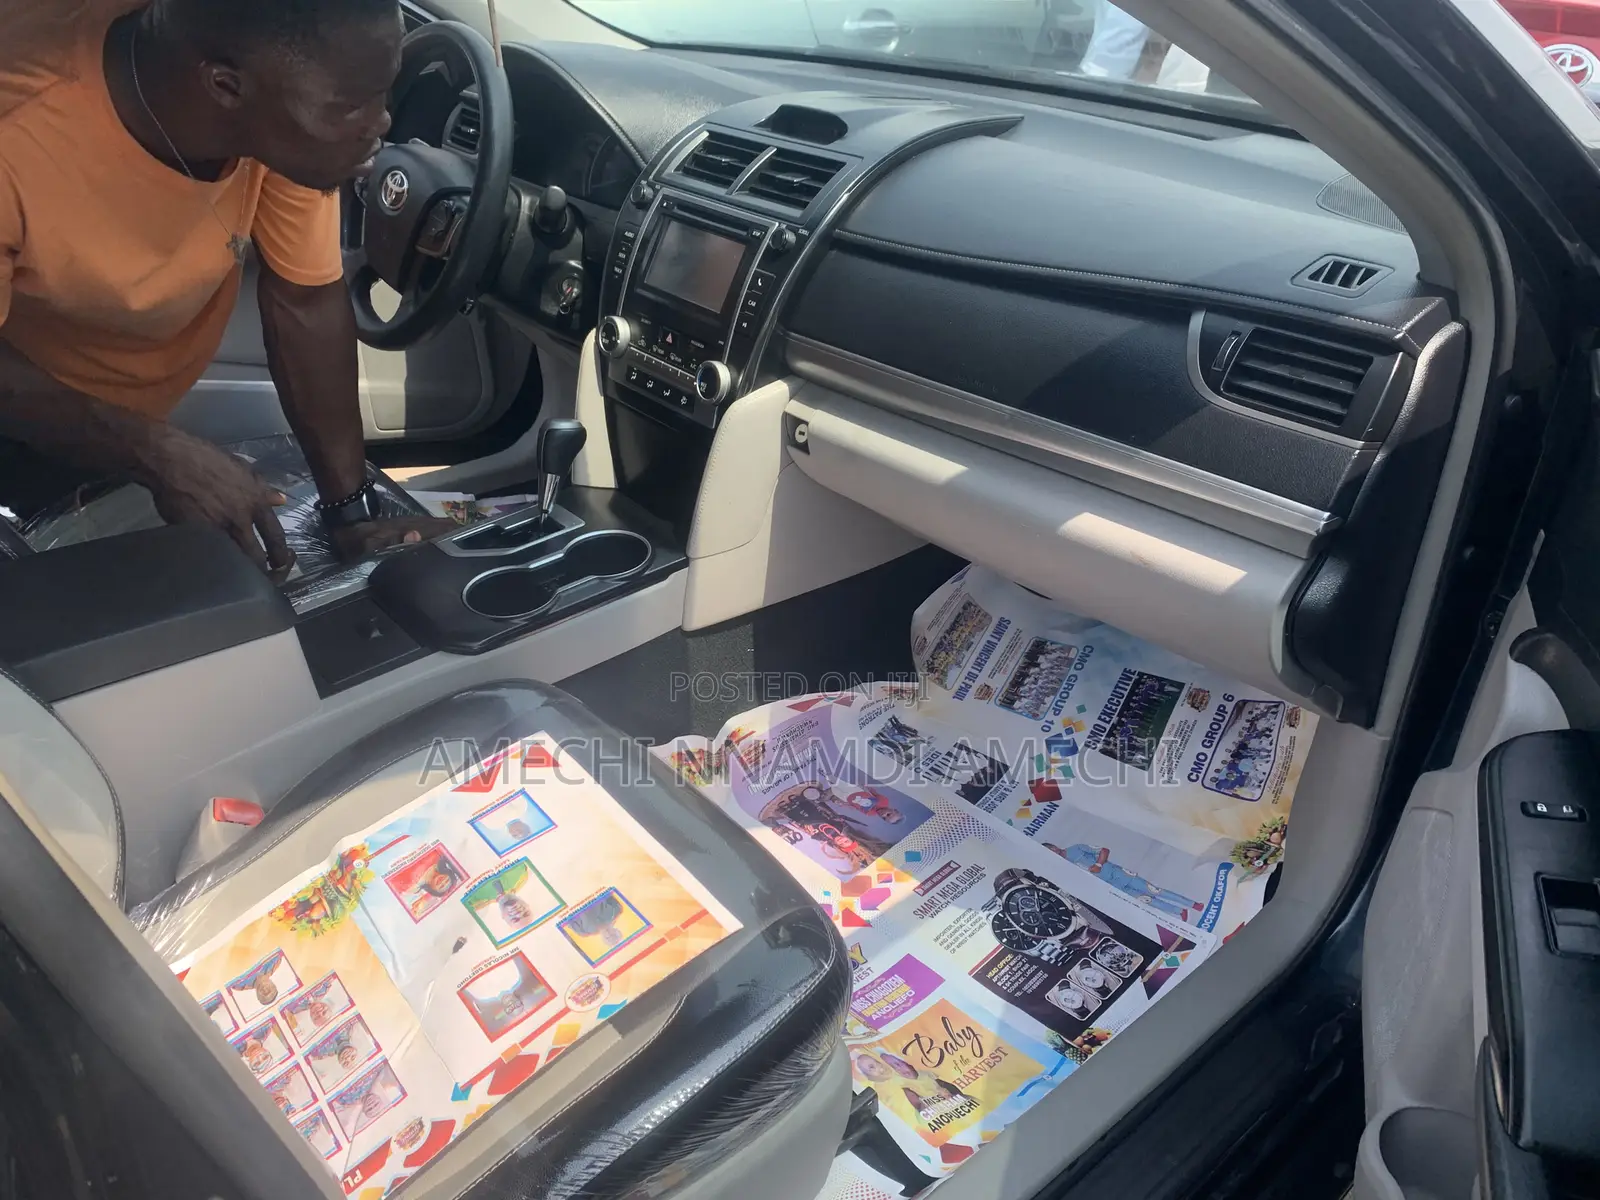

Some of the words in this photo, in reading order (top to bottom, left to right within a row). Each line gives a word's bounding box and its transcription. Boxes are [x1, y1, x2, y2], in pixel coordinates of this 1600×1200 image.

[748, 299, 757, 307] CAR
[989, 615, 1011, 642] SAINT
[970, 638, 998, 673] VINCENT
[1073, 643, 1094, 672] CMO
[952, 679, 972, 701] PAUL
[964, 669, 978, 683] DE
[1048, 672, 1081, 717] GROUP
[1084, 721, 1107, 750] CMO
[1097, 665, 1137, 724] EXECUTIVE
[1039, 717, 1055, 733] 10
[1186, 750, 1209, 783] CMO
[1201, 703, 1230, 749] GROUP
[1222, 691, 1235, 703] 6
[912, 895, 942, 920] SMART
[935, 879, 961, 900] MEGA
[955, 862, 985, 885] GLOBAL
[928, 898, 951, 918] WATCH
[950, 872, 986, 902] RESOURCES
[1213, 868, 1227, 901] OKAFOR
[985, 966, 998, 978] HEAD
[1010, 970, 1022, 982] TRADE
[872, 988, 916, 1021] ANOLIEFO
[902, 1016, 982, 1067] Baby
[952, 1045, 1008, 1090] HARVEST
[923, 1093, 946, 1107] MISS
[927, 1097, 980, 1133] ANOPUECHI
